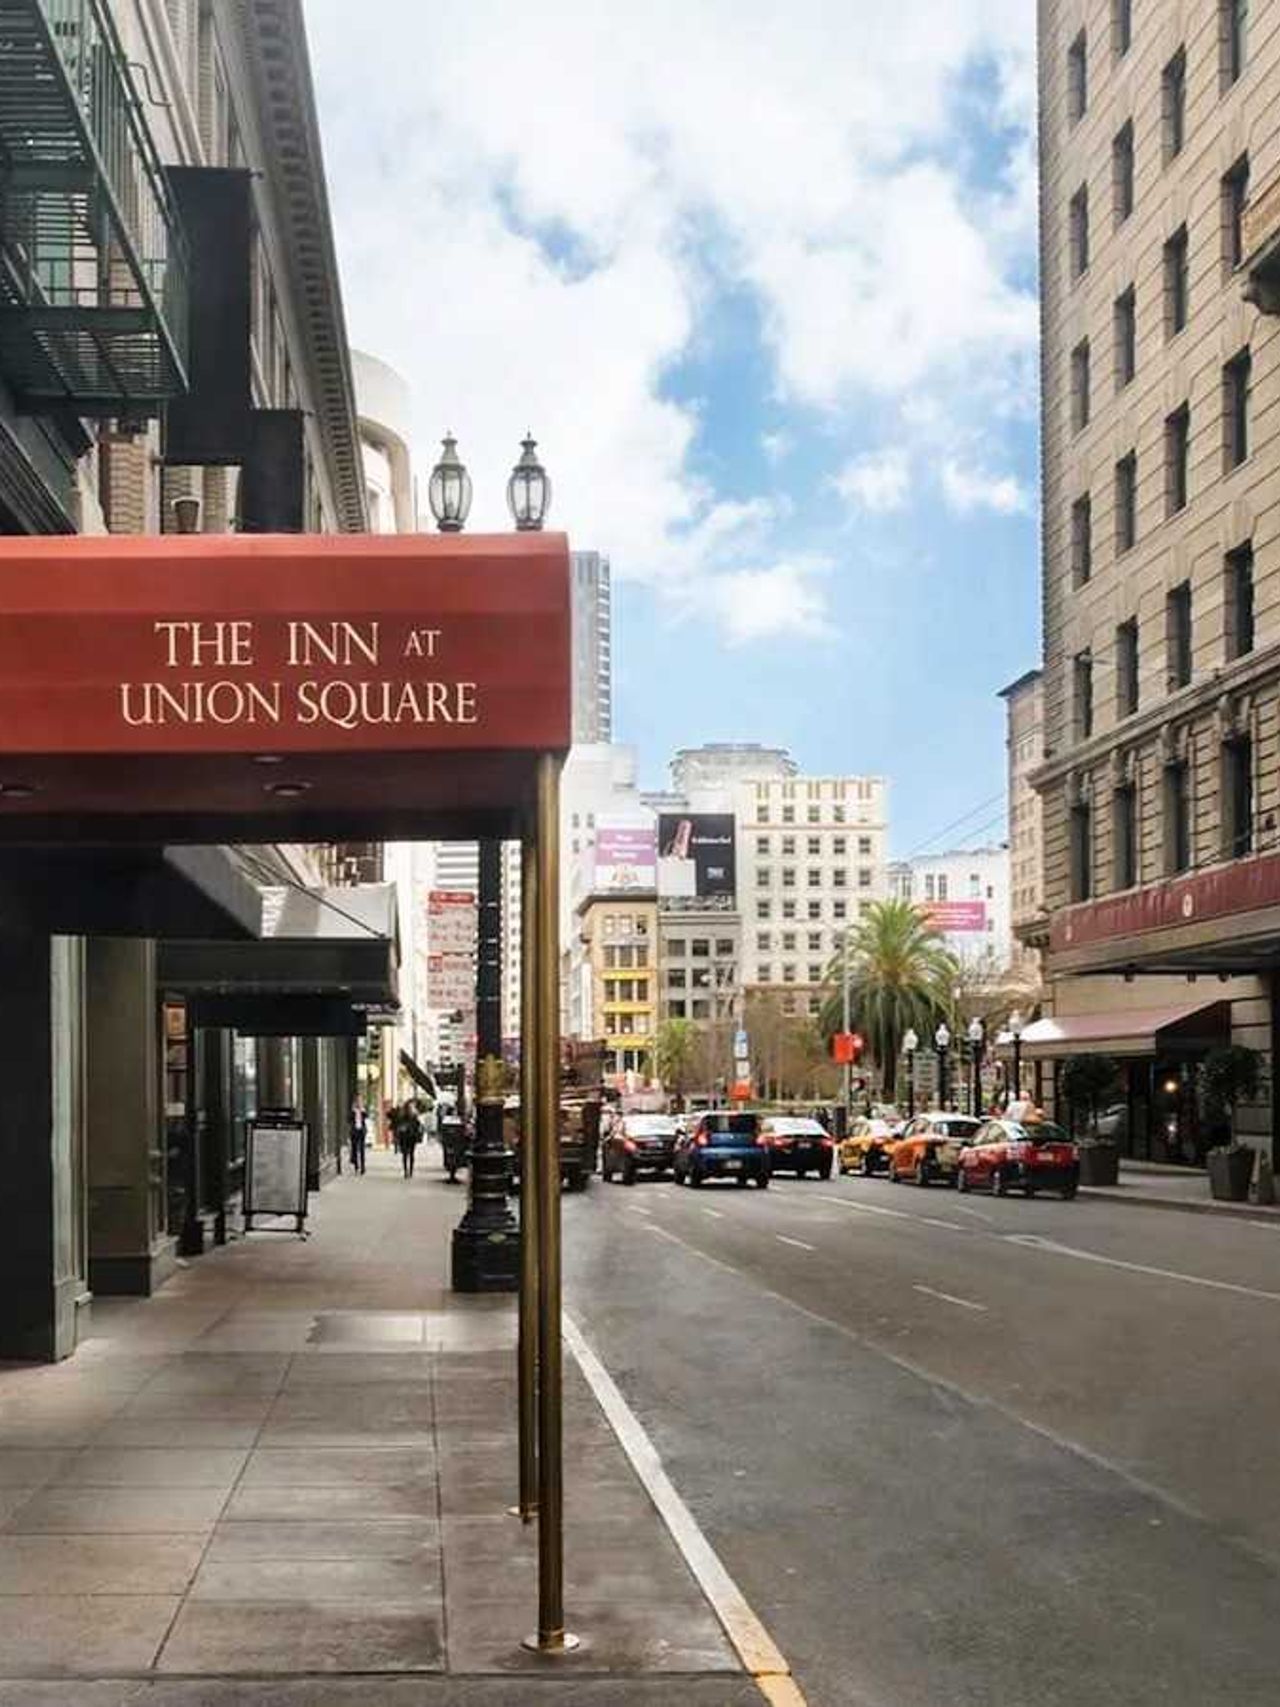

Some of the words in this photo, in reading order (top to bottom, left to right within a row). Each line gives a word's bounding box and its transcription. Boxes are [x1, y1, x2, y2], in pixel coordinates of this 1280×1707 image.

[154, 621, 253, 667] THE
[287, 621, 379, 666] INN
[404, 630, 441, 657] AT
[120, 681, 280, 725] UNION
[297, 681, 478, 729] SQUARE
